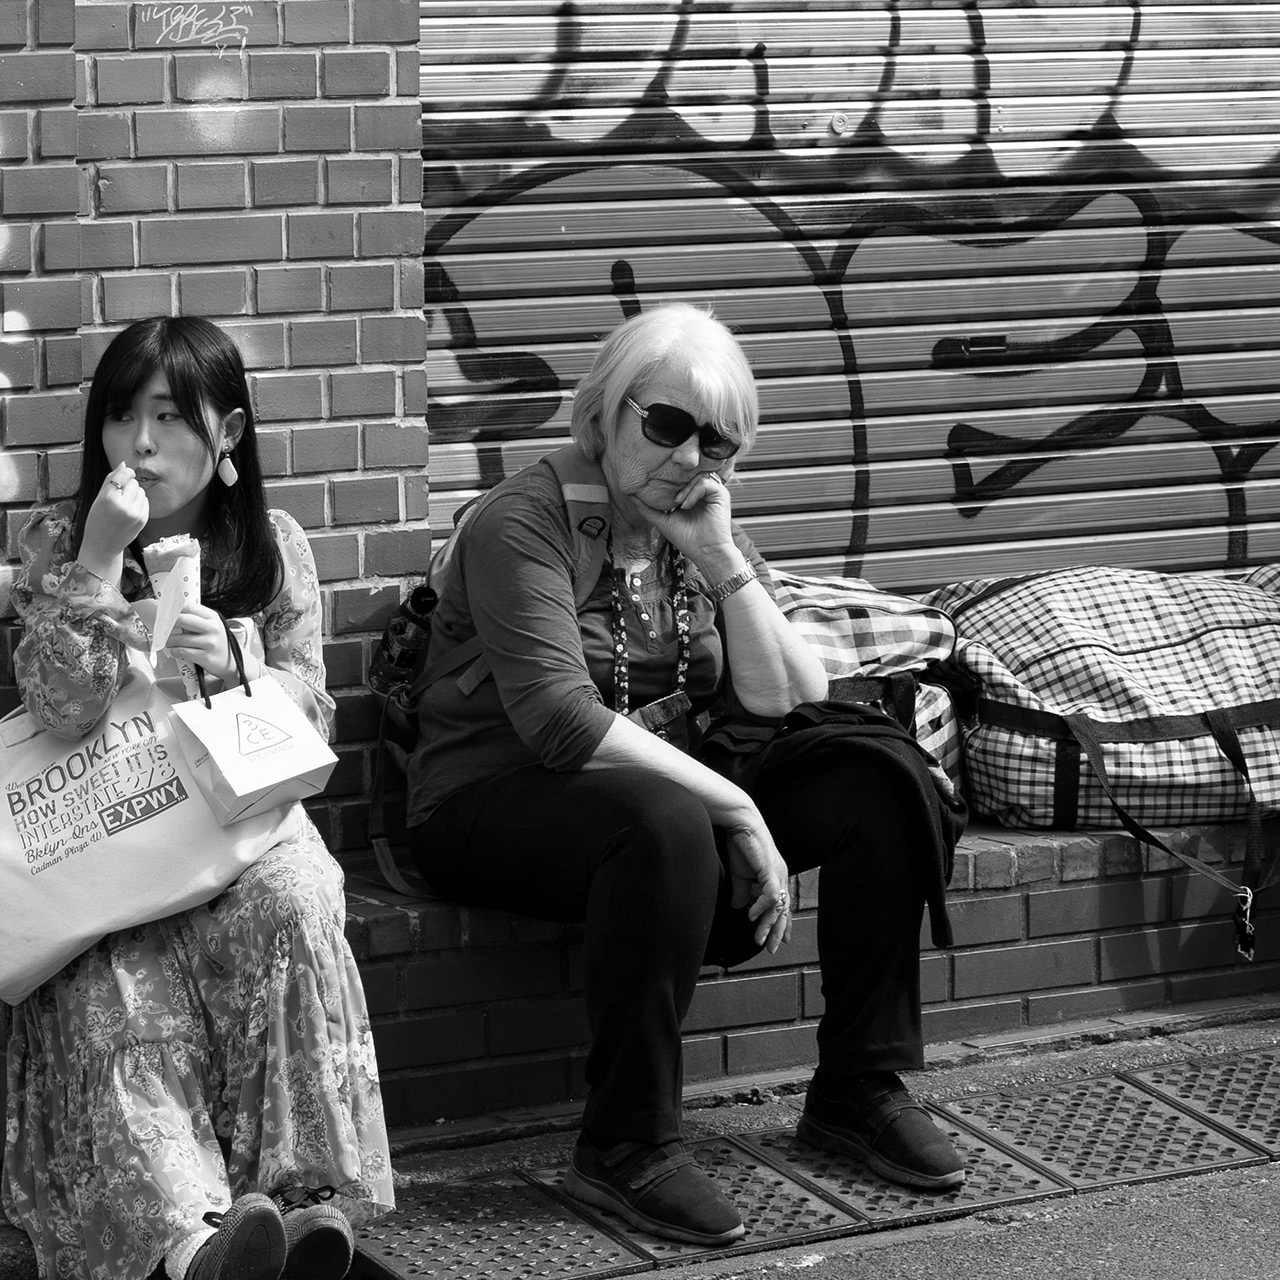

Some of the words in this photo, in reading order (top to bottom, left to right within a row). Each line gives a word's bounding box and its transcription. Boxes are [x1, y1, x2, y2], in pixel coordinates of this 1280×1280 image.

[6, 710, 156, 817] BROOKLYN
[103, 751, 119, 764] NEW
[120, 743, 141, 756] YORK
[142, 734, 159, 747] CITY
[246, 741, 296, 764] STYLENANDA
[14, 799, 57, 833] HOW
[62, 760, 121, 808] SWEET
[125, 751, 143, 773] IT
[147, 743, 169, 765] IS
[19, 780, 128, 850] INTERSTATE
[24, 819, 100, 865] Bklyn-Qns
[30, 854, 64, 876] Cadman
[64, 839, 90, 860] Plaza
